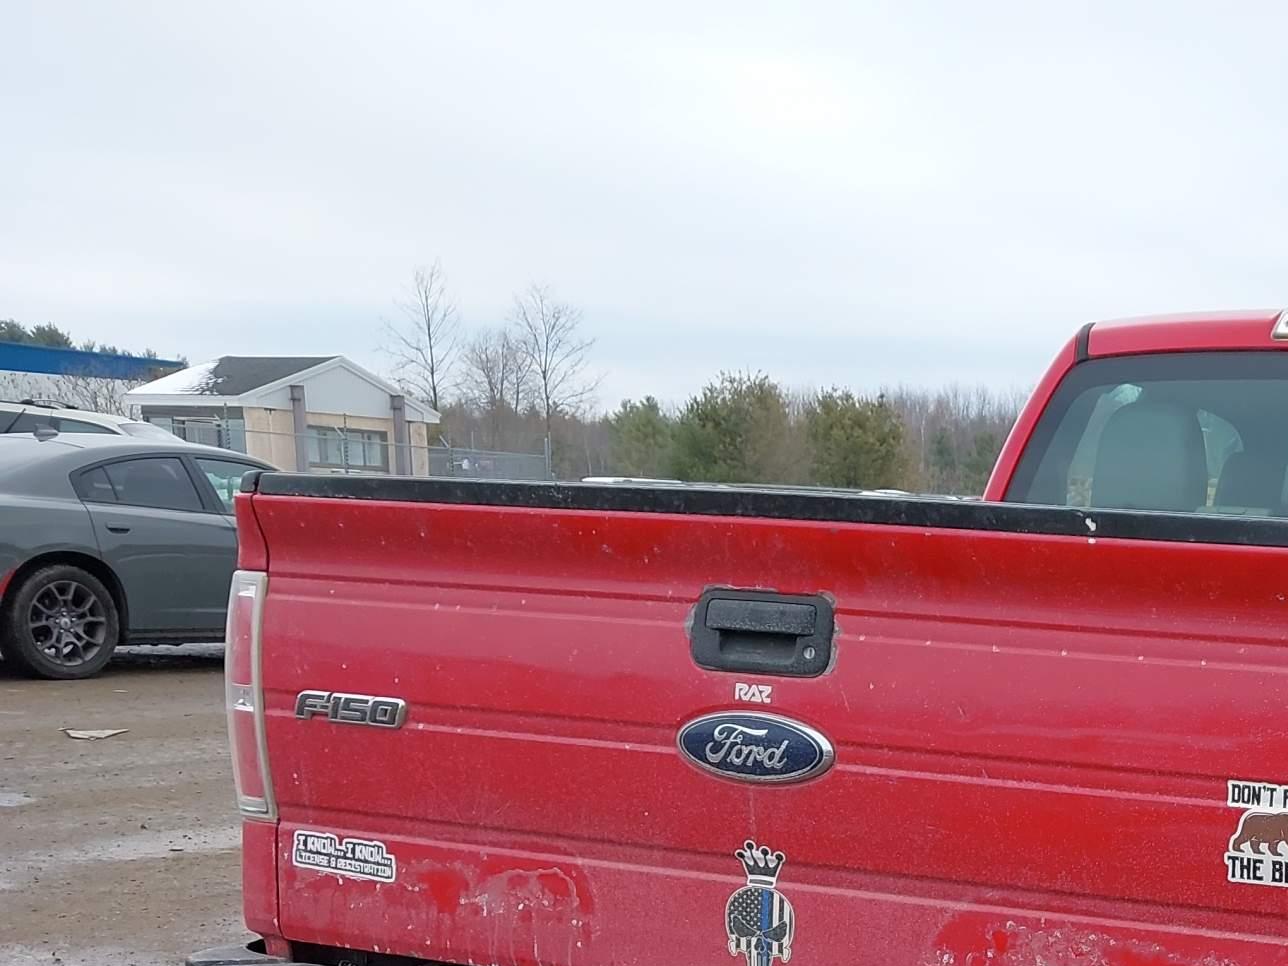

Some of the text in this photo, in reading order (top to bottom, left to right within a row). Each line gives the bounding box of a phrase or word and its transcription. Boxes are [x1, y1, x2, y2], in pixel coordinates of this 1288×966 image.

[735, 683, 773, 703] RAZ
[295, 690, 407, 728] F-150
[705, 723, 790, 769] Ford
[1231, 783, 1277, 807] DON'T
[296, 850, 329, 867] LICENSE
[337, 858, 392, 878] REGISTRATION
[1228, 855, 1264, 881] THE
